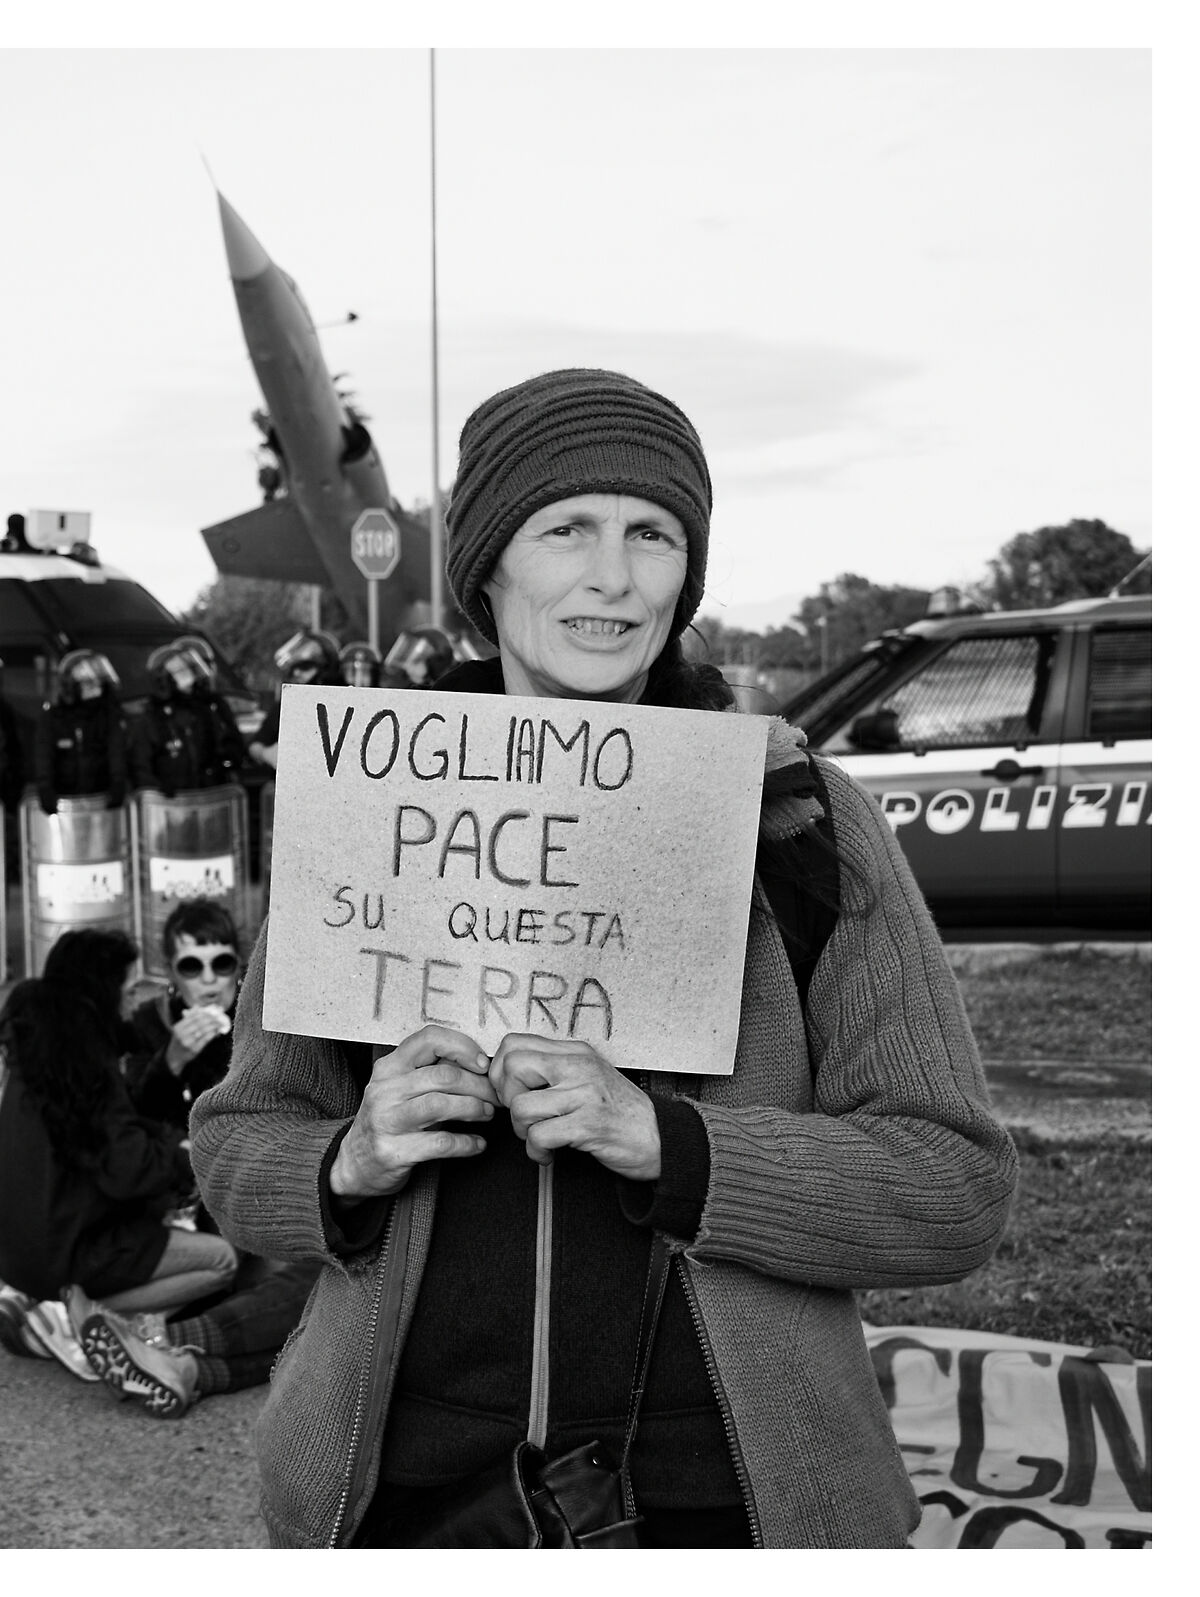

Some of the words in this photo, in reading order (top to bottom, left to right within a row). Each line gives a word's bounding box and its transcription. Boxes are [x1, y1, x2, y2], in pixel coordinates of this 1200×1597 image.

[355, 530, 393, 557] STOP
[316, 702, 634, 791] VOGLIAMO
[881, 781, 1152, 835] POLIZI
[392, 804, 580, 888] PACE
[323, 885, 386, 931] SU
[448, 901, 629, 950] QUESTA
[359, 947, 614, 1042] TERRA
